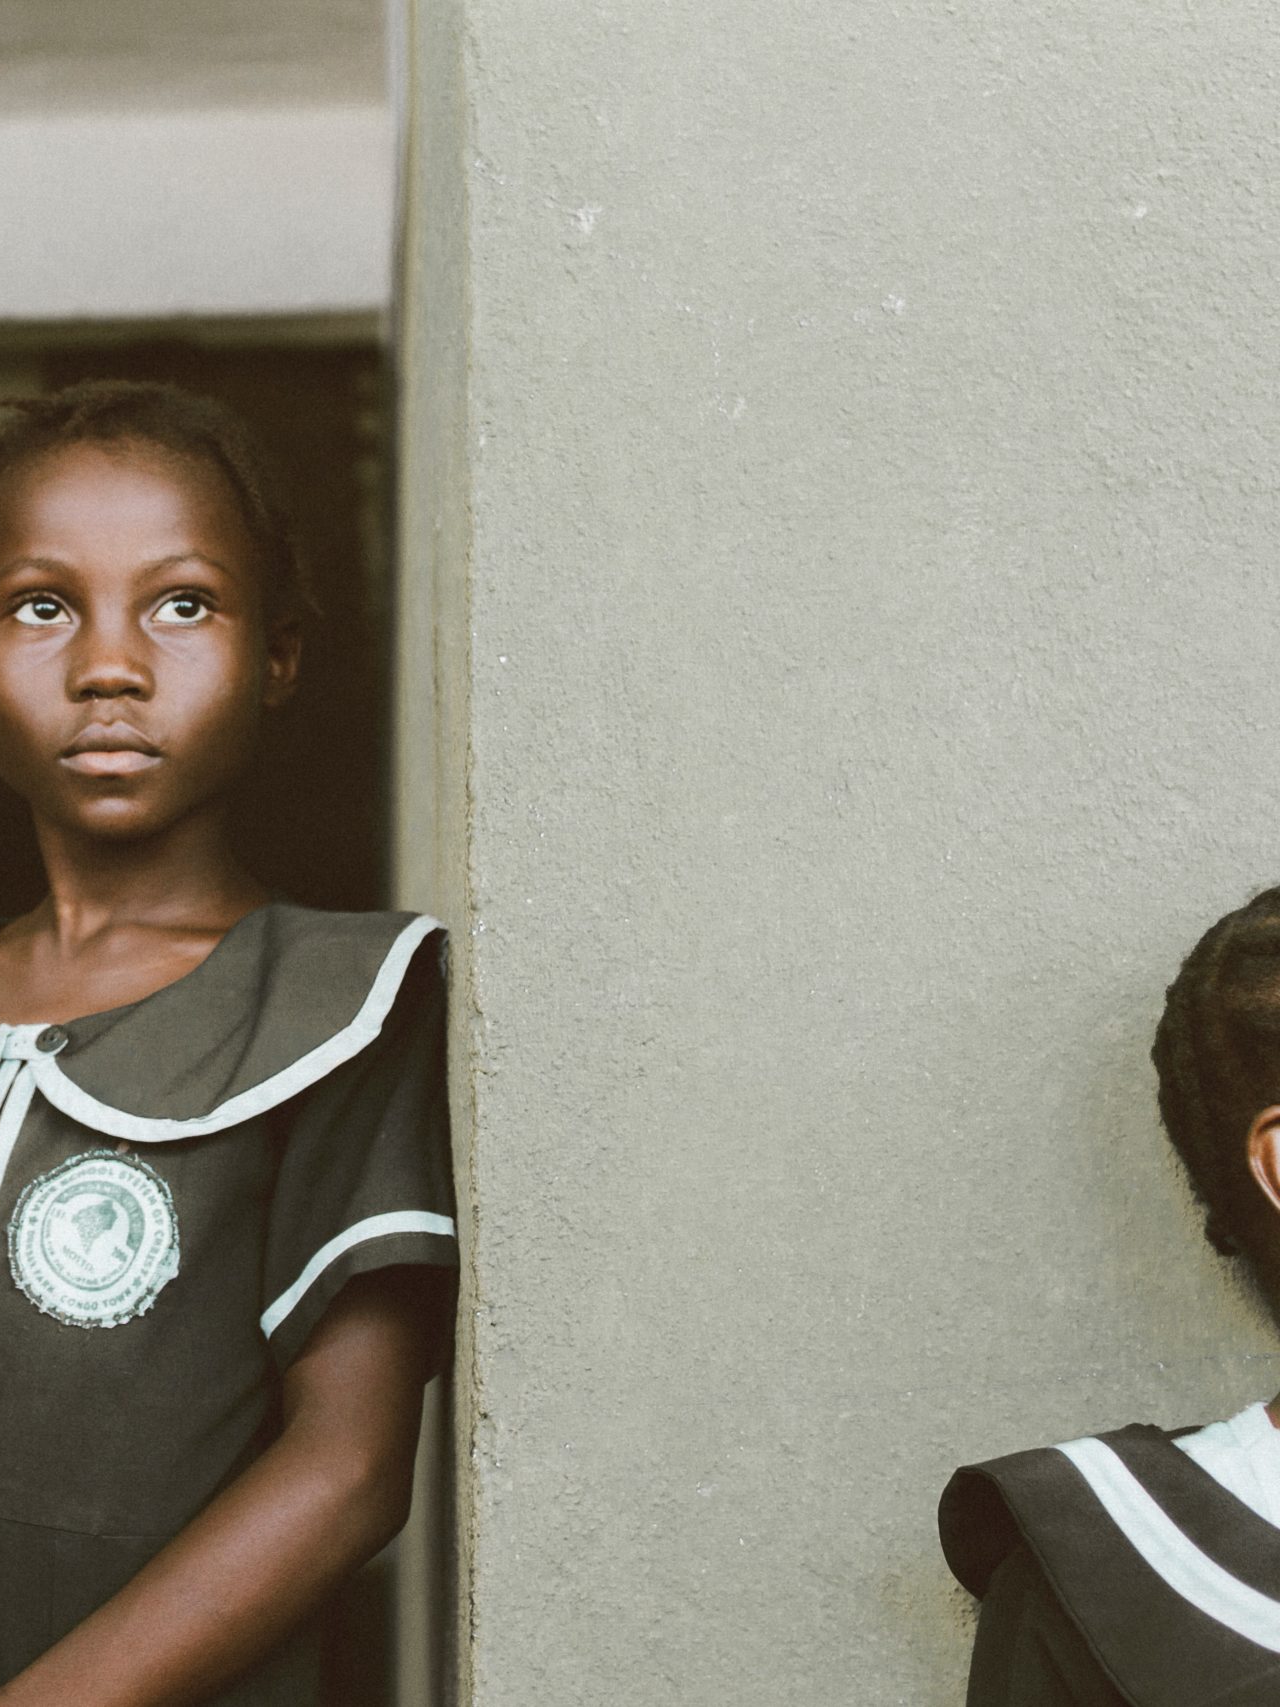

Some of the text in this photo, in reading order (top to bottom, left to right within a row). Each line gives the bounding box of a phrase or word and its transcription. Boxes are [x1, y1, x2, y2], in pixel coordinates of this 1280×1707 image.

[60, 1165, 114, 1186] SCHOOL
[118, 1169, 158, 1206] SYSTEM
[151, 1208, 165, 1227] OF
[140, 1229, 165, 1278] CHRIST
[101, 1286, 133, 1308] TOWN
